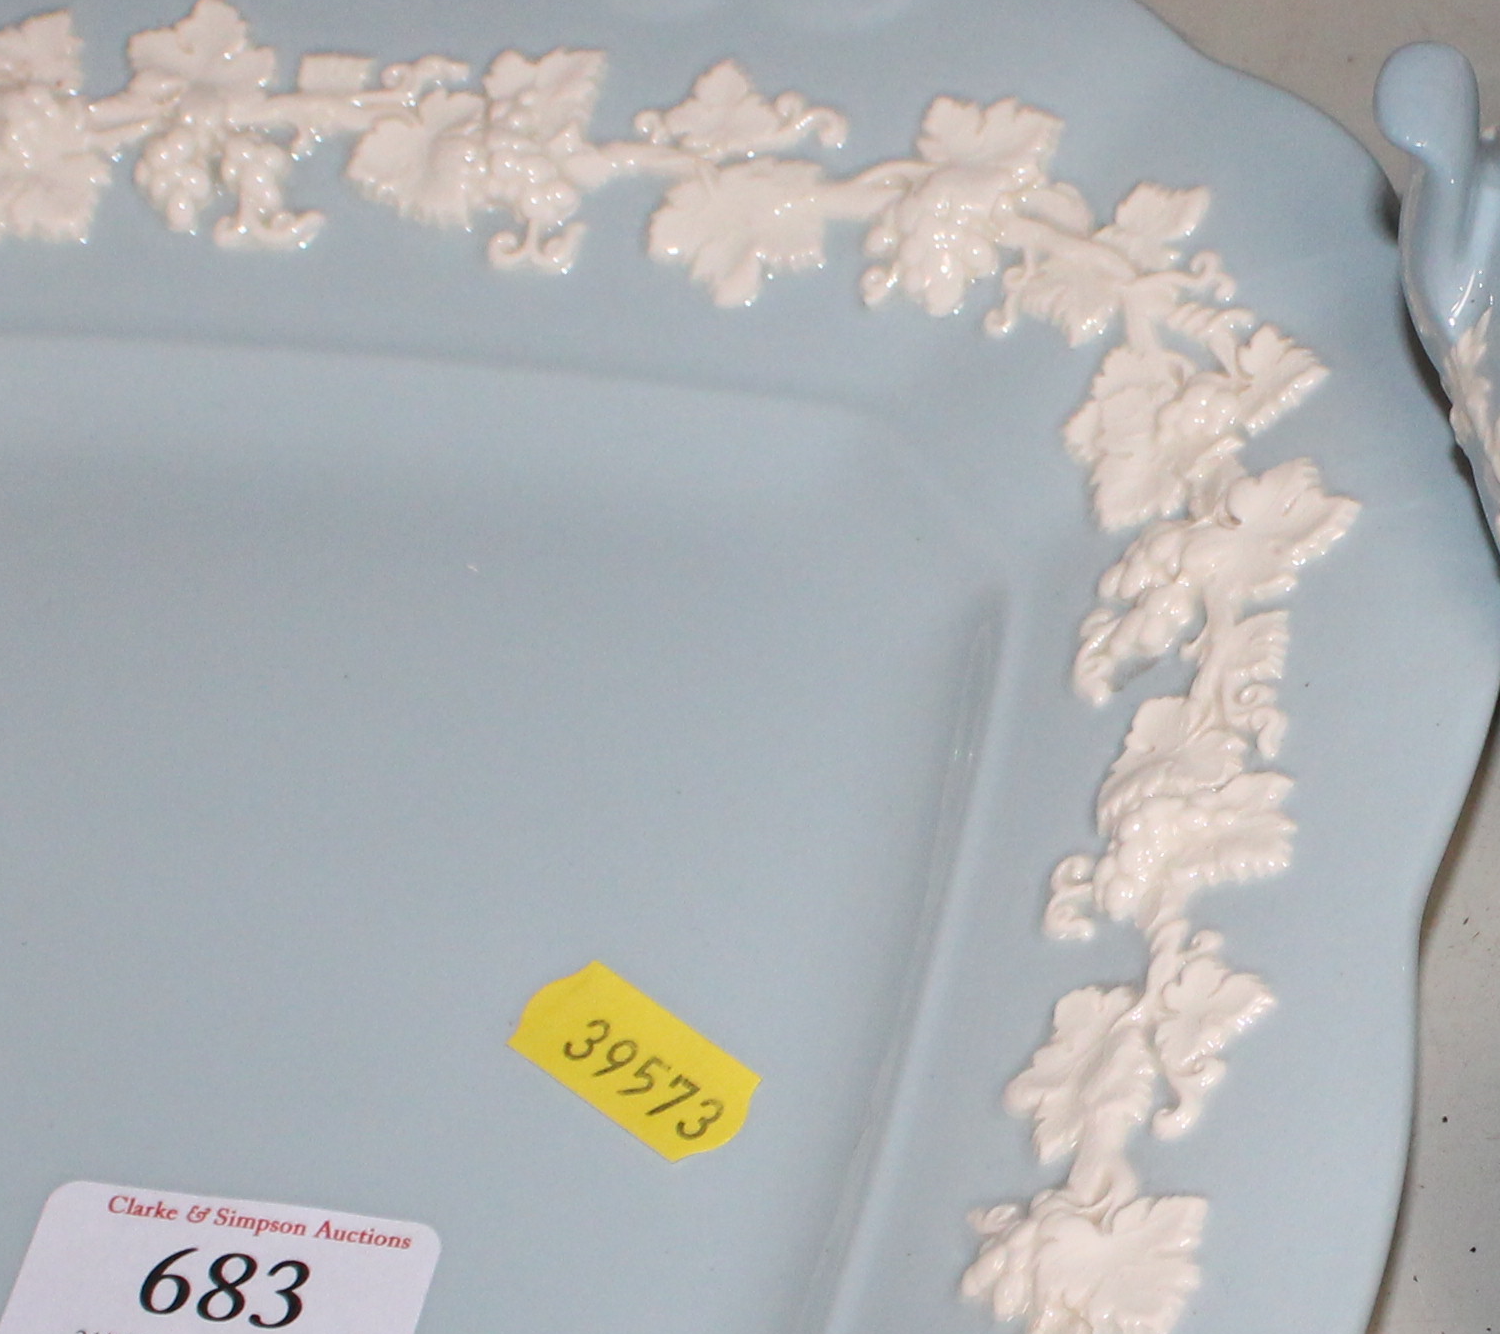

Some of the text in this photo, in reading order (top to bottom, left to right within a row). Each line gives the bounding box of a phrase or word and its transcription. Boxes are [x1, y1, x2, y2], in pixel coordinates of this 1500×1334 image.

[563, 1019, 724, 1140] 39573
[107, 1195, 412, 1249] Clarke & Simpson Auctions
[139, 1247, 311, 1329] 683
